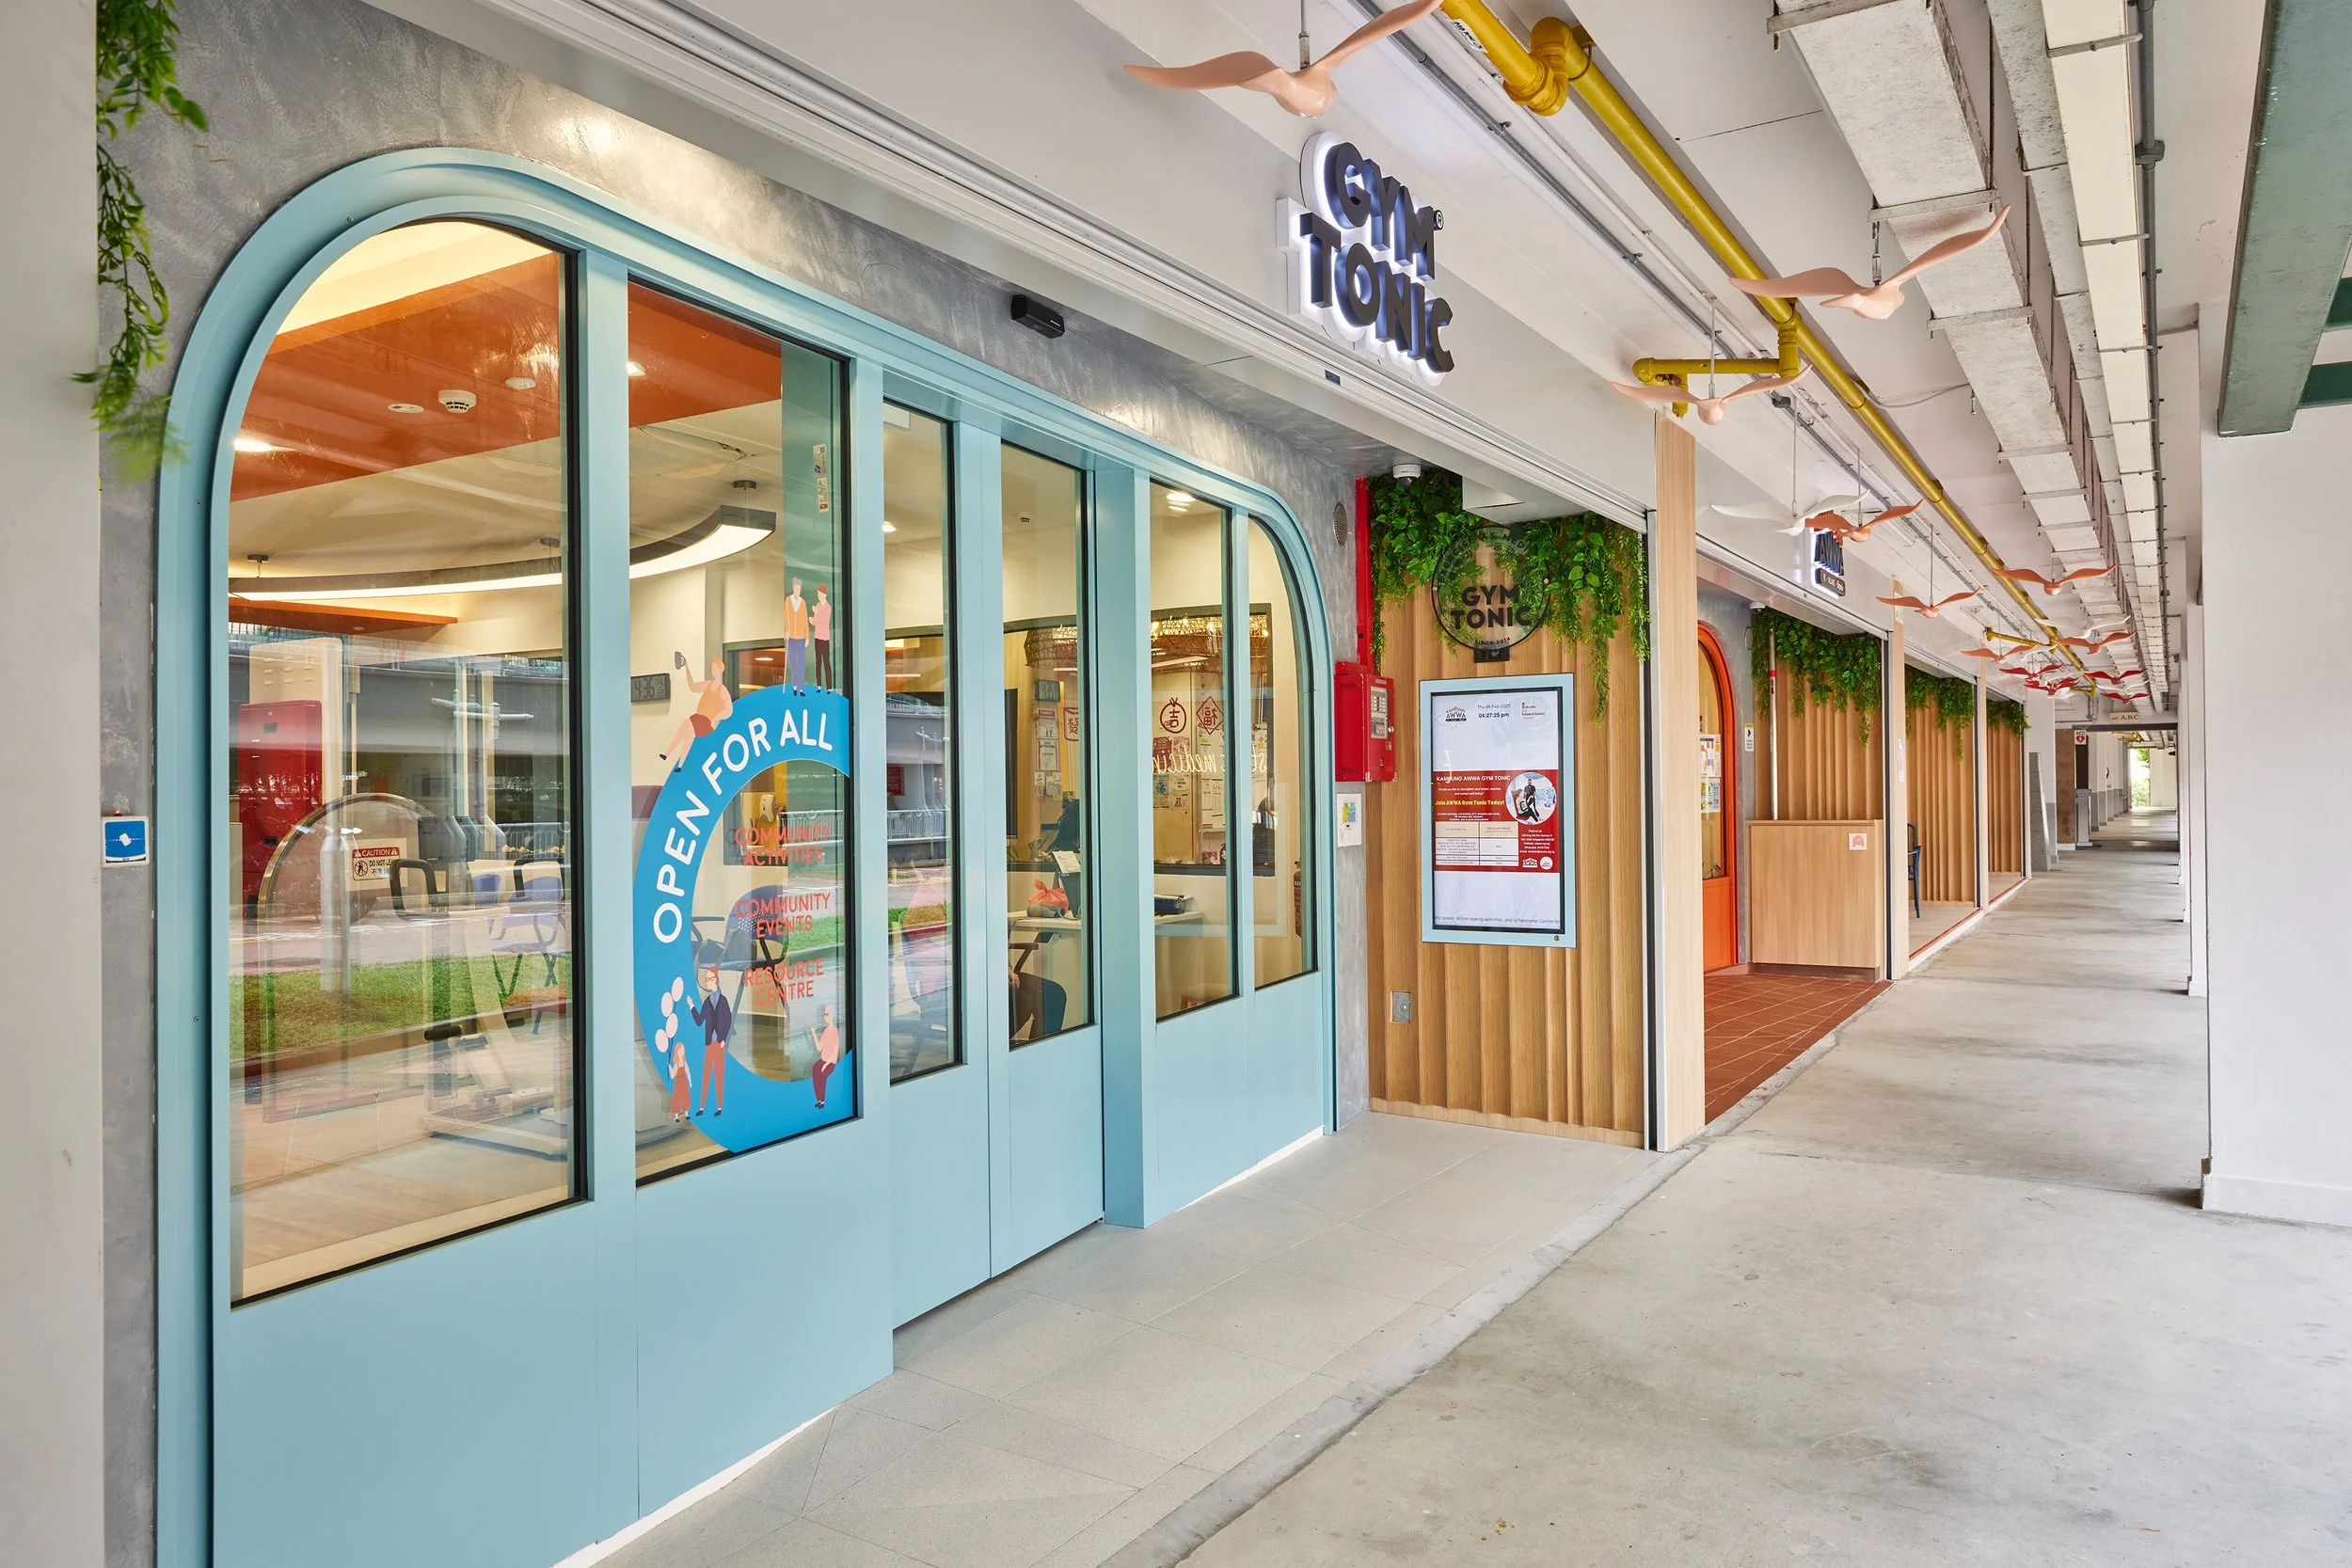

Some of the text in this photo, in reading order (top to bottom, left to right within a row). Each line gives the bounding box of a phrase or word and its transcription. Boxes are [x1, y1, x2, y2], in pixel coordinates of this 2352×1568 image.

[1324, 142, 1436, 281] GYM
[1300, 213, 1455, 373] TONIC
[1462, 584, 1520, 607] GYM
[1451, 606, 1533, 629] TONIC
[653, 708, 834, 943] OPEN FOR ALL
[735, 824, 831, 847] COMMUNITY
[743, 845, 823, 867] ACTIVITIES
[736, 893, 832, 920] COMMUNITY
[756, 914, 813, 939] EVENTS
[744, 958, 824, 988] RESOURCE
[755, 981, 815, 1006] CENTRE
